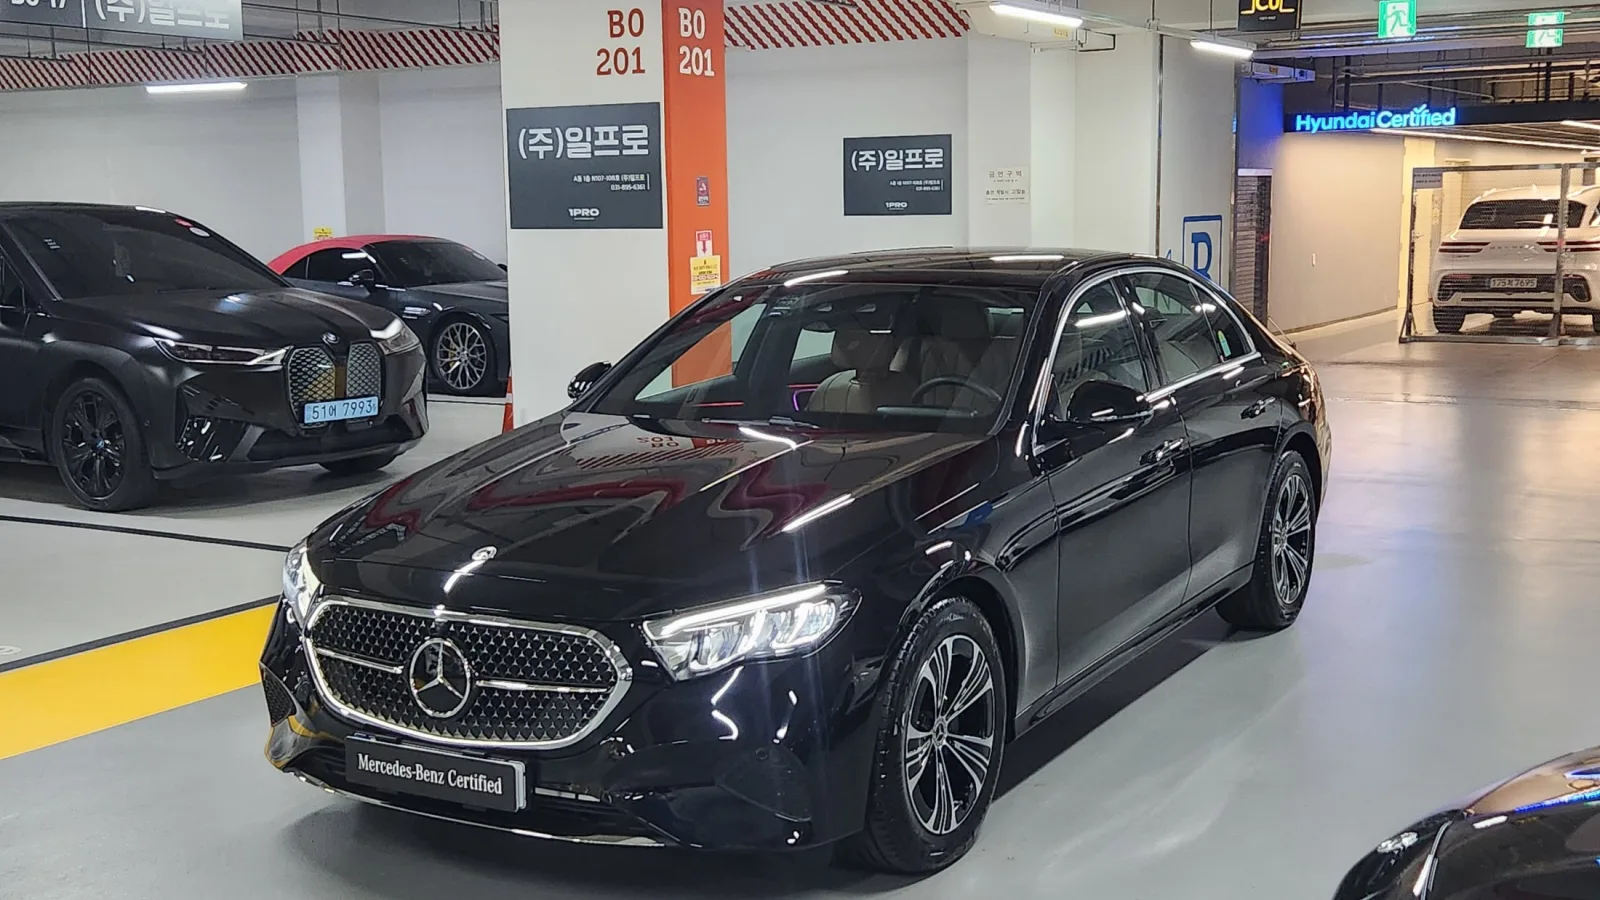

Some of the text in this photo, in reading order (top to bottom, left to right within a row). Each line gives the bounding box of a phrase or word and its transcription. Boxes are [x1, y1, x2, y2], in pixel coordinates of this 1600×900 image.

[596, 47, 646, 76] 201
[679, 46, 715, 77] 201
[1296, 104, 1457, 133] Hyundai Certified
[518, 125, 649, 159] (주)일프로
[851, 148, 944, 171] (주)일프로
[568, 208, 600, 217] 1PRO
[312, 404, 337, 419] 51어
[342, 400, 373, 416] 7993
[357, 753, 503, 795] Mercedes-Benz Certified
